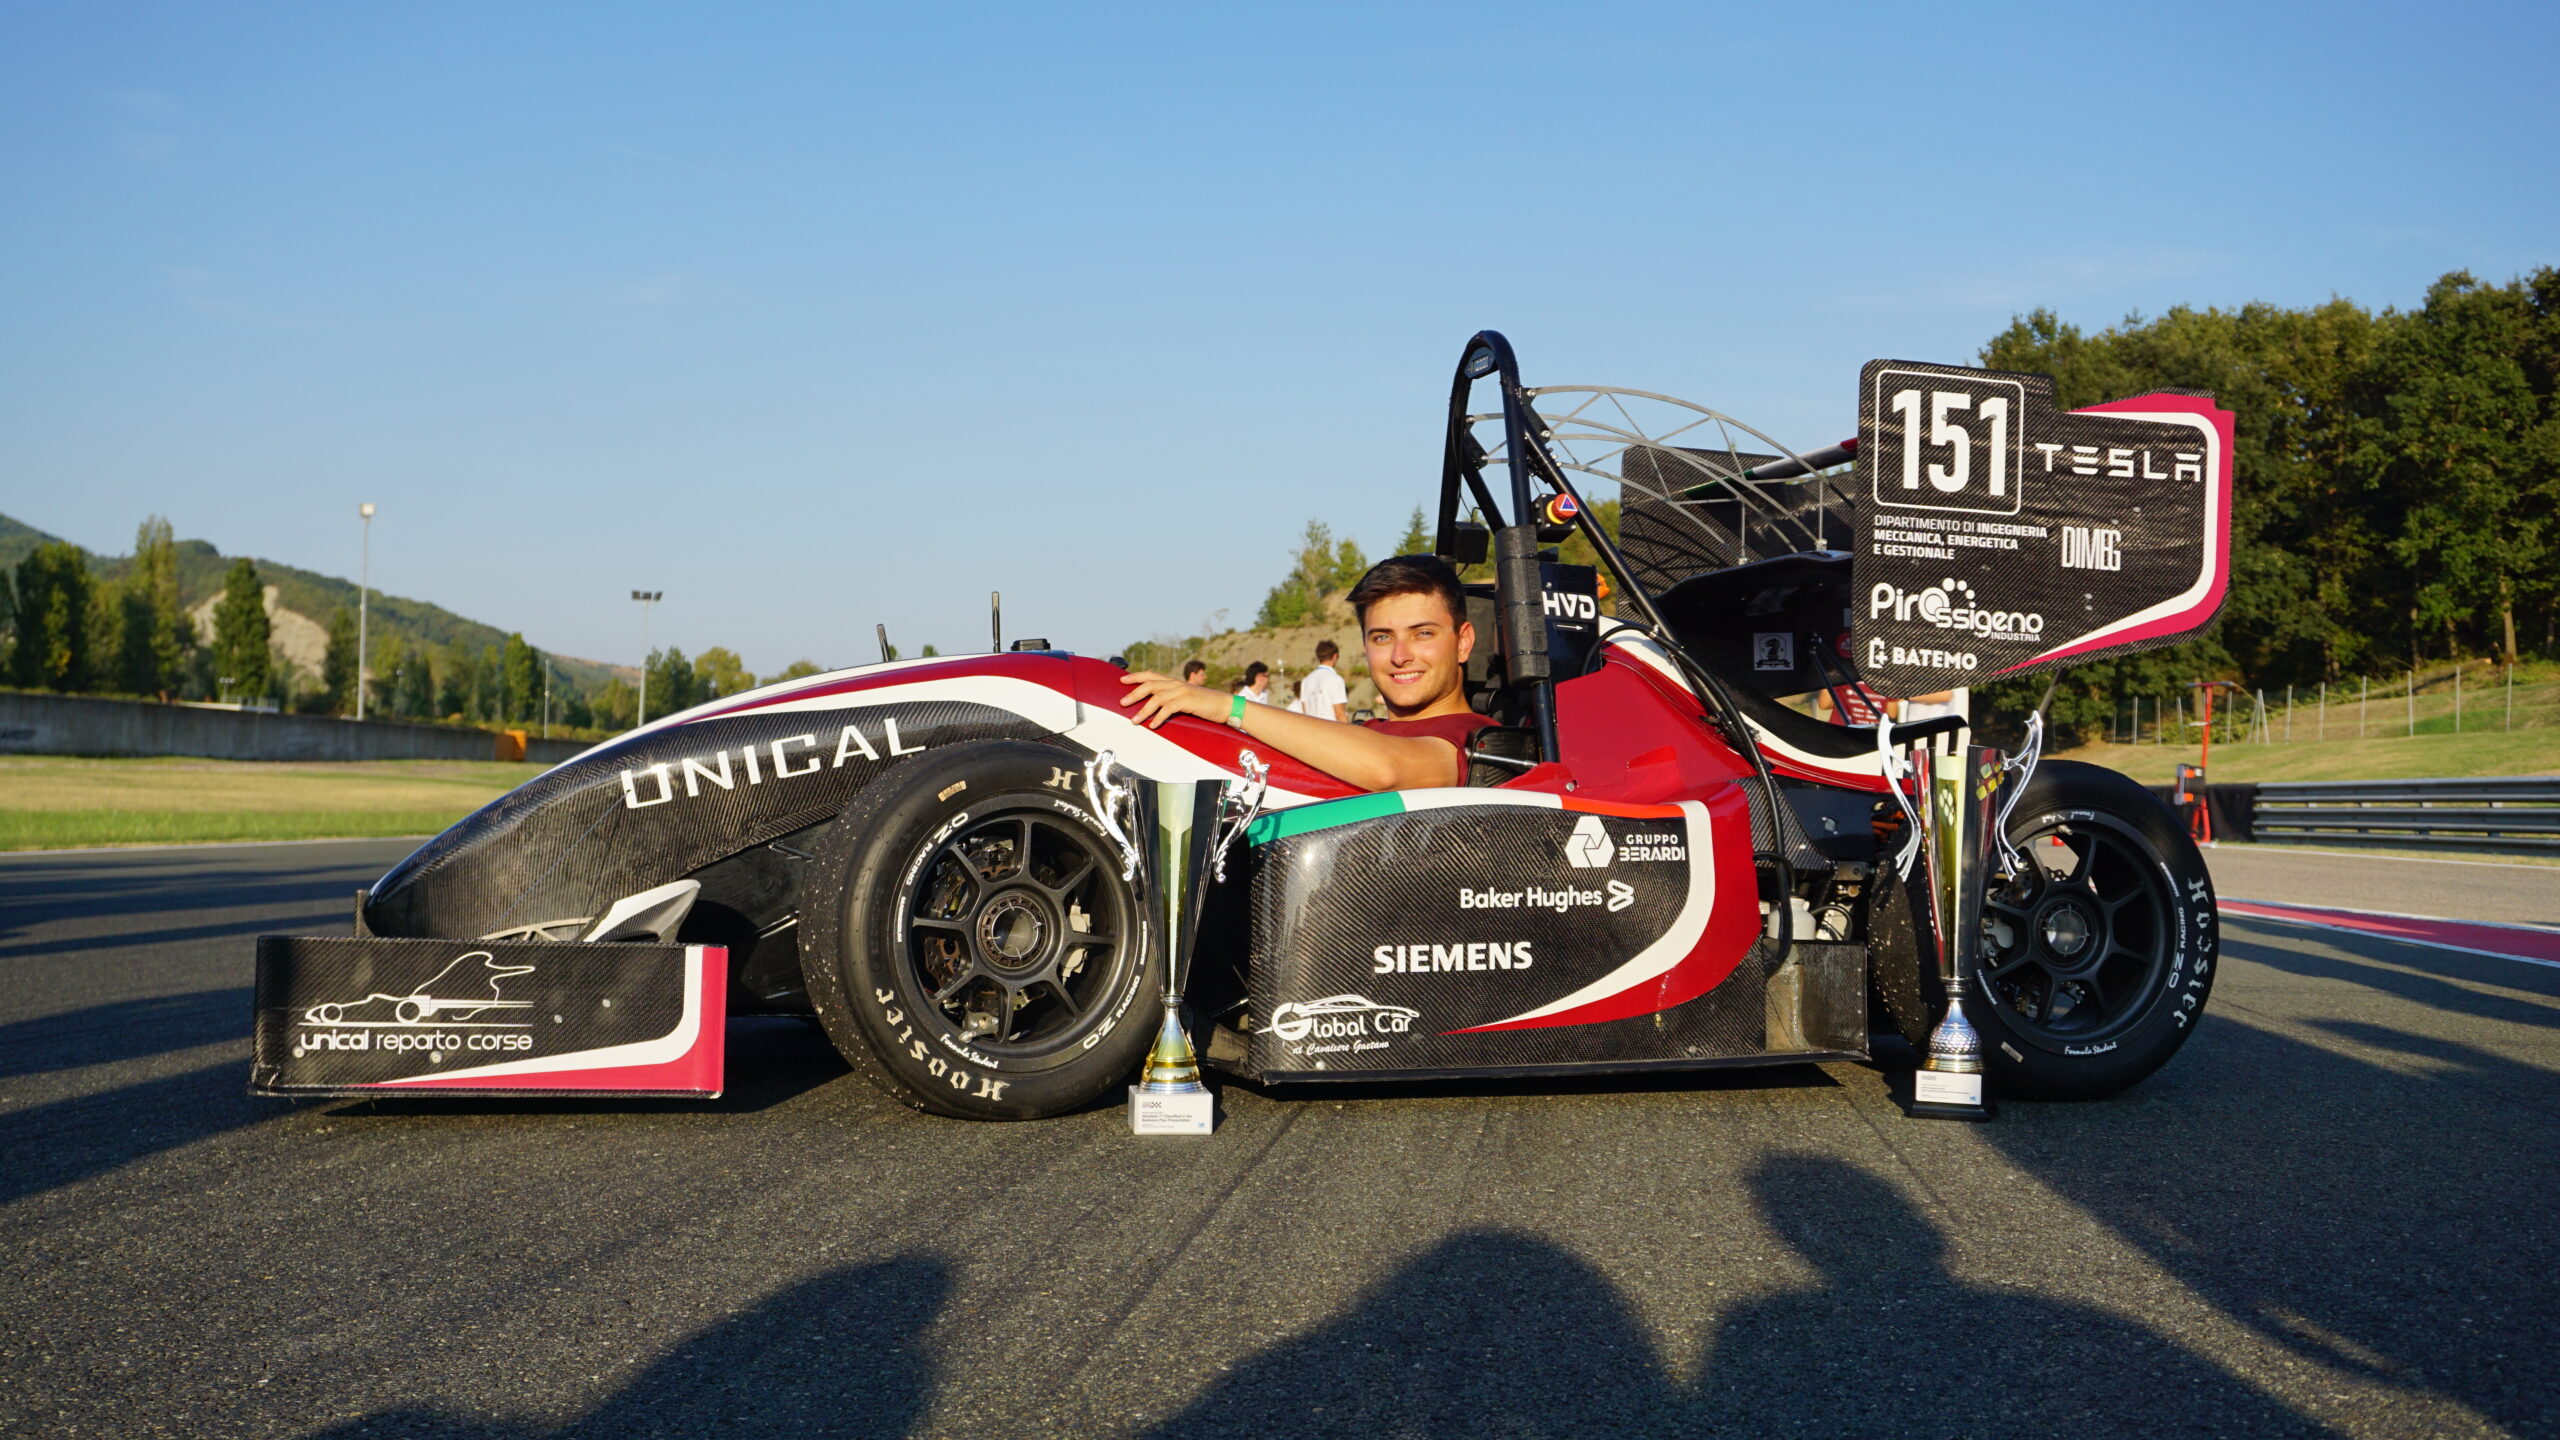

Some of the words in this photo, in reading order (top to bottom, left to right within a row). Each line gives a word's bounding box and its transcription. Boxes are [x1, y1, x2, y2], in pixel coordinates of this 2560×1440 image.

[1892, 389, 2008, 496] 151
[2035, 443, 2201, 482] TESLA
[1874, 514, 1961, 532] DIPARTIMENTO
[1963, 521, 1975, 533] DI
[1977, 523, 2048, 538] INGEGNERIA
[1873, 543, 1882, 555] E
[1884, 544, 1955, 560] GESTIONALE
[1874, 529, 1945, 546] MECCANICA,
[1947, 535, 2018, 550] ENERGETICA
[1541, 590, 1596, 619] HVD
[1991, 632, 2041, 642] INDUSTRIA
[1892, 646, 1978, 670] BATEMO
[621, 718, 926, 809] UNICAL
[1626, 834, 1679, 846] GRUPPO
[905, 842, 934, 887] RACING
[1619, 846, 1687, 862] BERARDI
[1459, 888, 1525, 910] Baker
[1526, 887, 1604, 913] Hughes
[2178, 906, 2187, 949] RACING
[1373, 942, 1533, 974] SIEMENS
[1115, 975, 1141, 1019] RACING
[1374, 1012, 1412, 1033] Car
[300, 1029, 369, 1051] unical
[376, 1031, 462, 1054] reparto
[467, 1031, 533, 1051] corse
